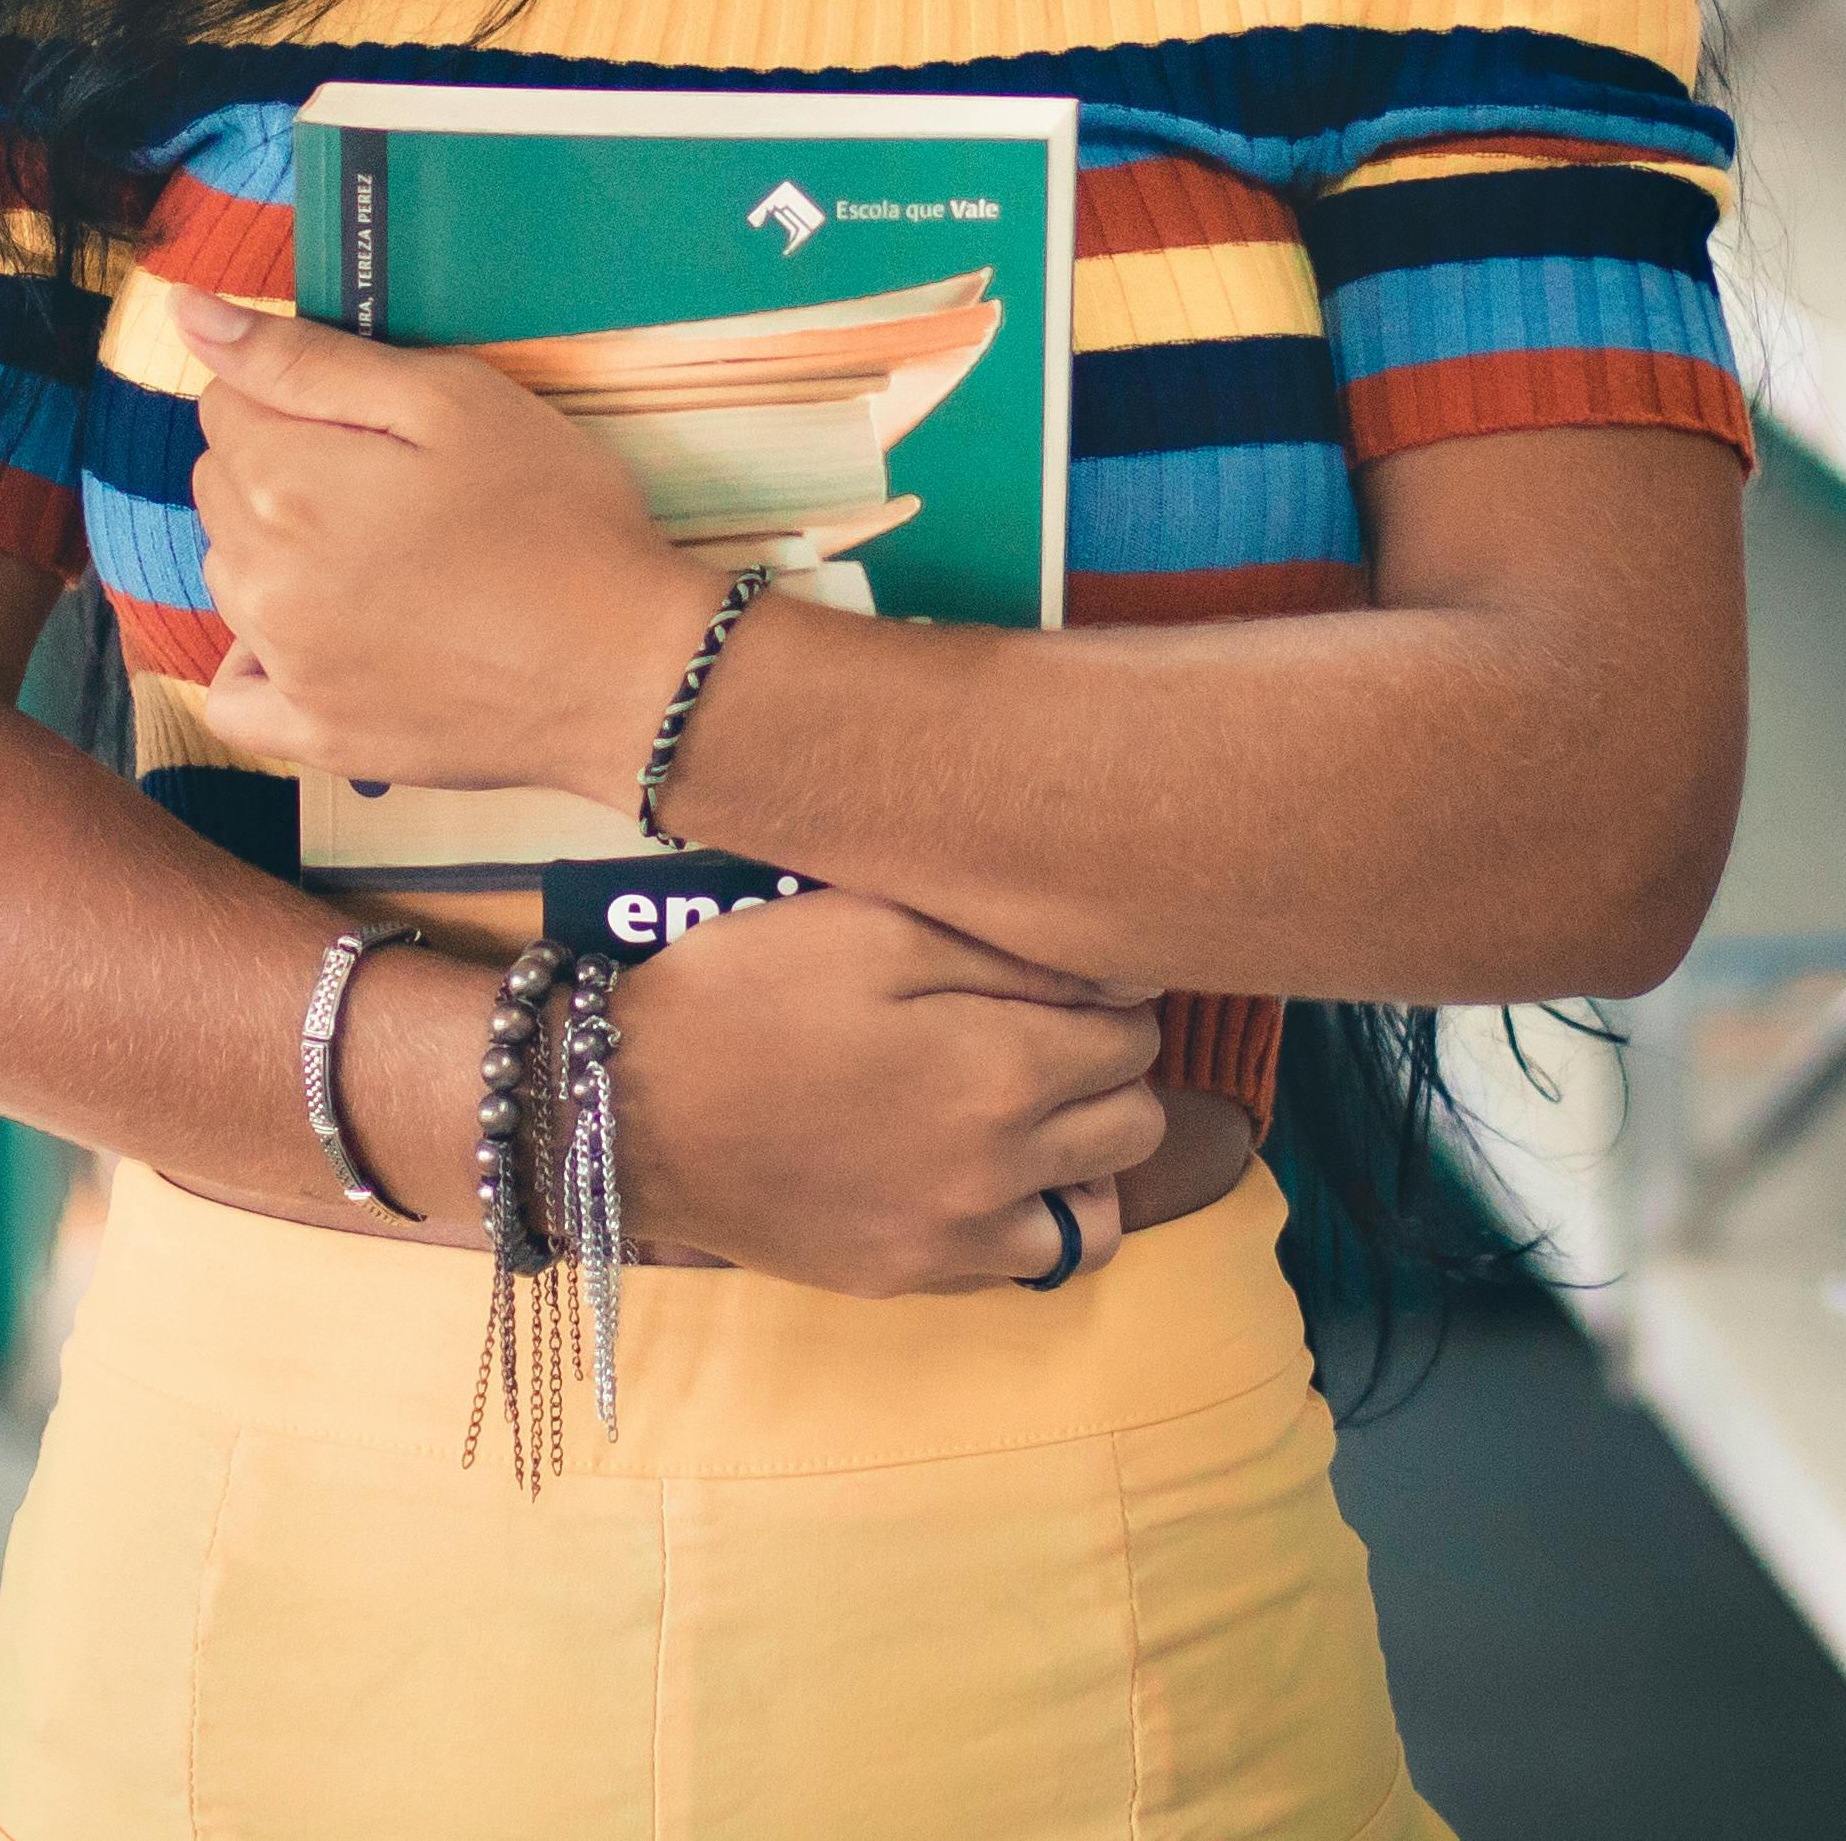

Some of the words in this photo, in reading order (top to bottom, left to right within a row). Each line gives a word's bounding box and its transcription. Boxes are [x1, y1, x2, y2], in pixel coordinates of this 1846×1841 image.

[356, 172, 374, 224] PEREZ
[835, 200, 901, 220] Escola
[905, 204, 945, 223] que
[948, 198, 1001, 220] Vale
[357, 228, 374, 289] TEREZA
